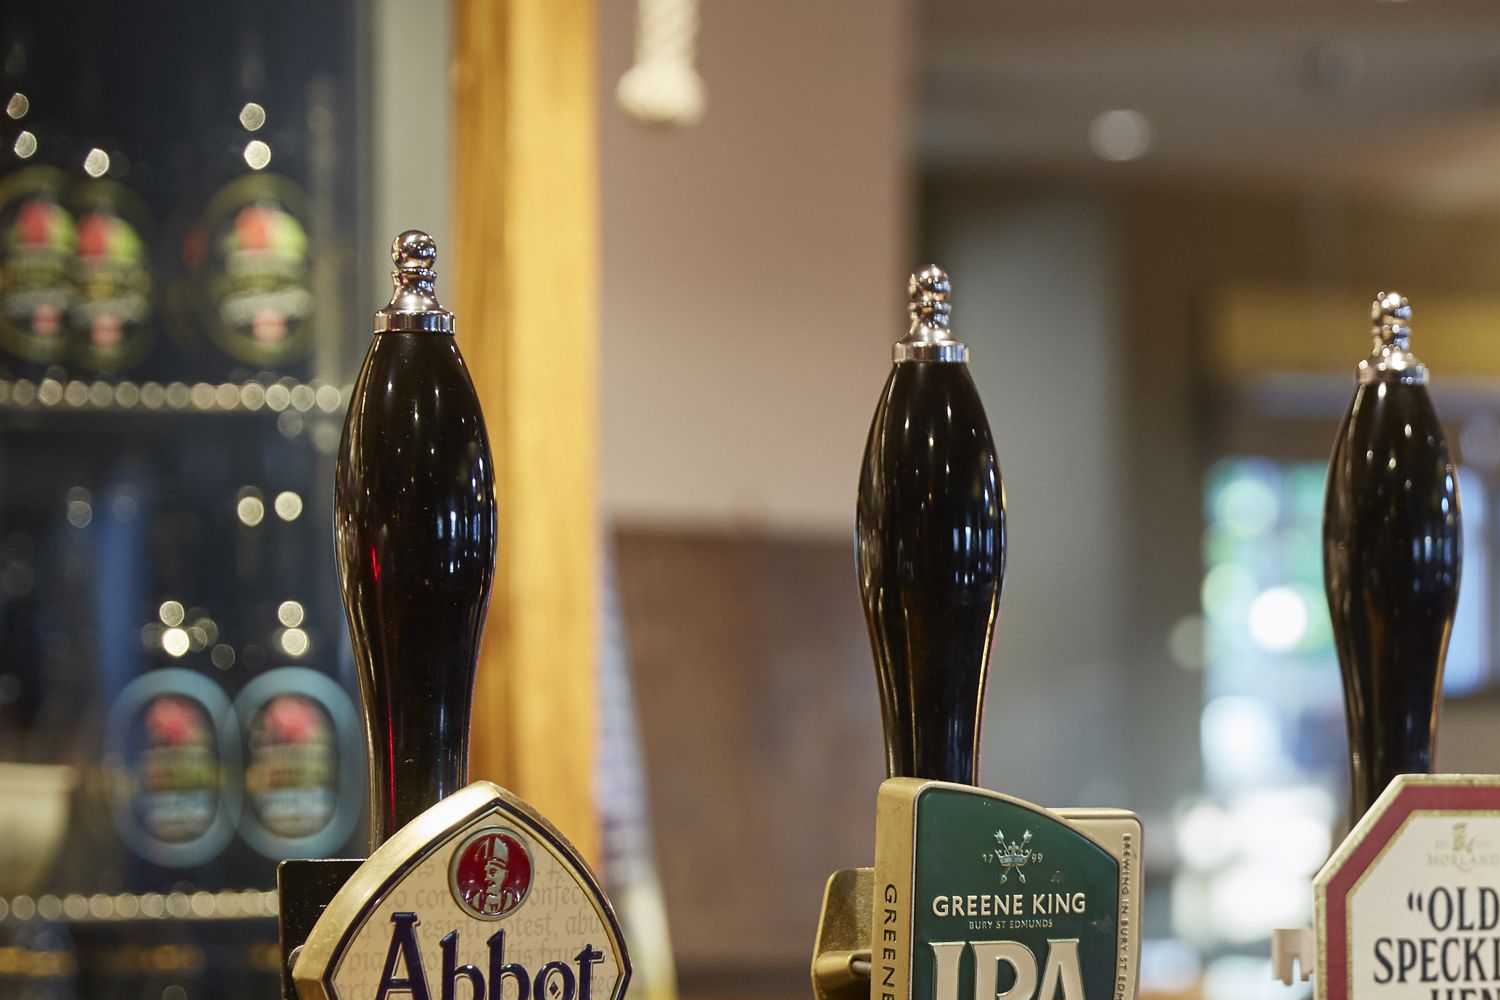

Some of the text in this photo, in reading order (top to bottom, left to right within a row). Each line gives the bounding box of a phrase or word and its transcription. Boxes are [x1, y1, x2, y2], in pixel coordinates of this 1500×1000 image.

[1121, 833, 1131, 895] BREWING
[932, 892, 1086, 917] GREENE KING
[1121, 899, 1128, 914] IN
[1407, 886, 1500, 931] "OLD
[969, 918, 1053, 930] BURY ST EDMUNDS
[1120, 919, 1128, 951] BURY
[1119, 956, 1127, 970] ST
